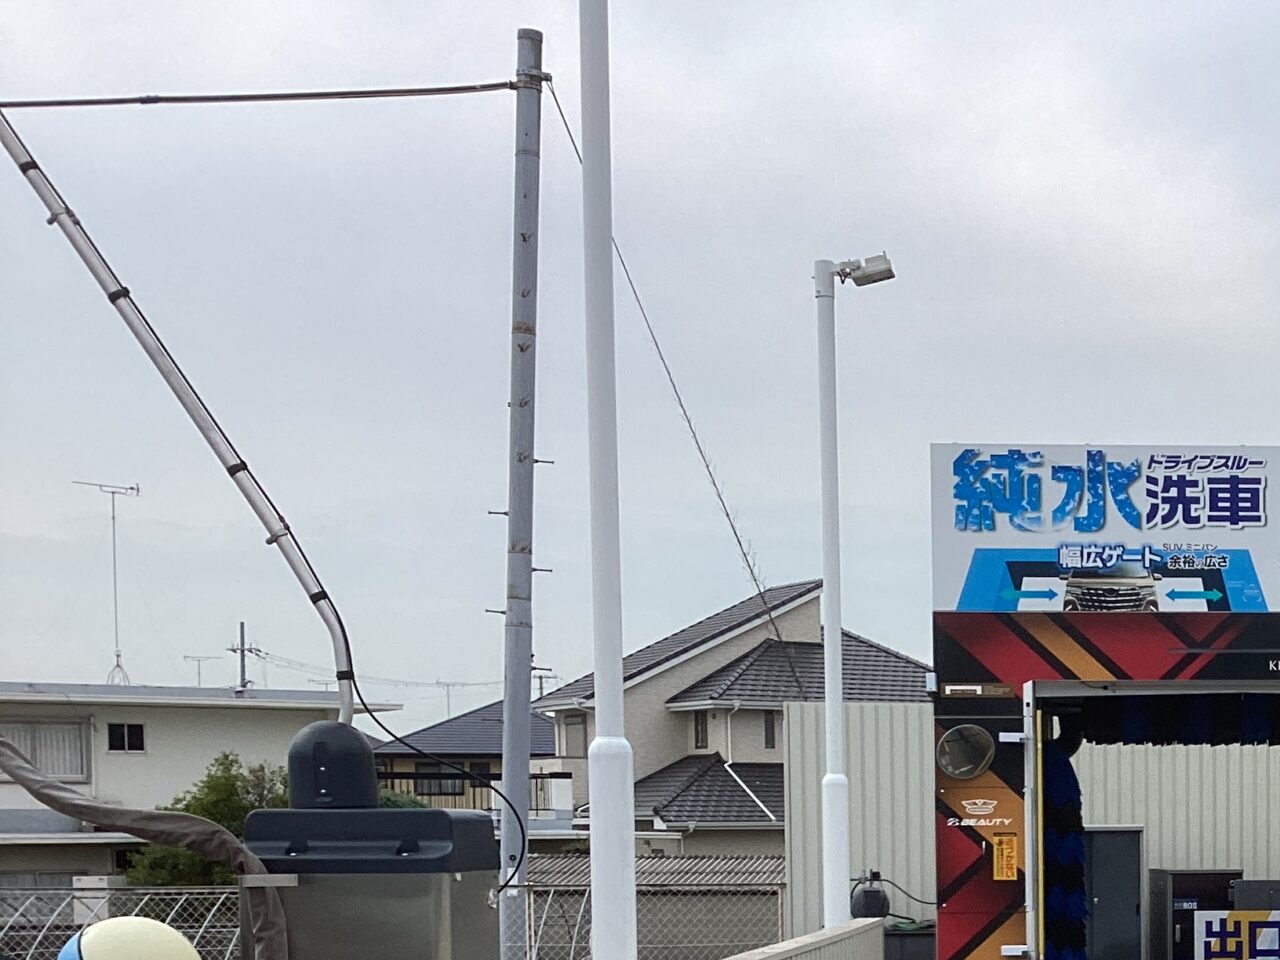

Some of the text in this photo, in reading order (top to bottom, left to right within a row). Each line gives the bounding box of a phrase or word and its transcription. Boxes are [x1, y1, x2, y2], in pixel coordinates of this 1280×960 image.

[1148, 455, 1265, 470] ドライブスルー
[953, 449, 1143, 532] 純水
[1146, 475, 1262, 525] 洗車
[1162, 543, 1183, 551] SUV
[1059, 545, 1163, 569] 幅広ゲート
[1169, 554, 1228, 567] 余裕の広さ
[961, 818, 1013, 826] BEAUTY
